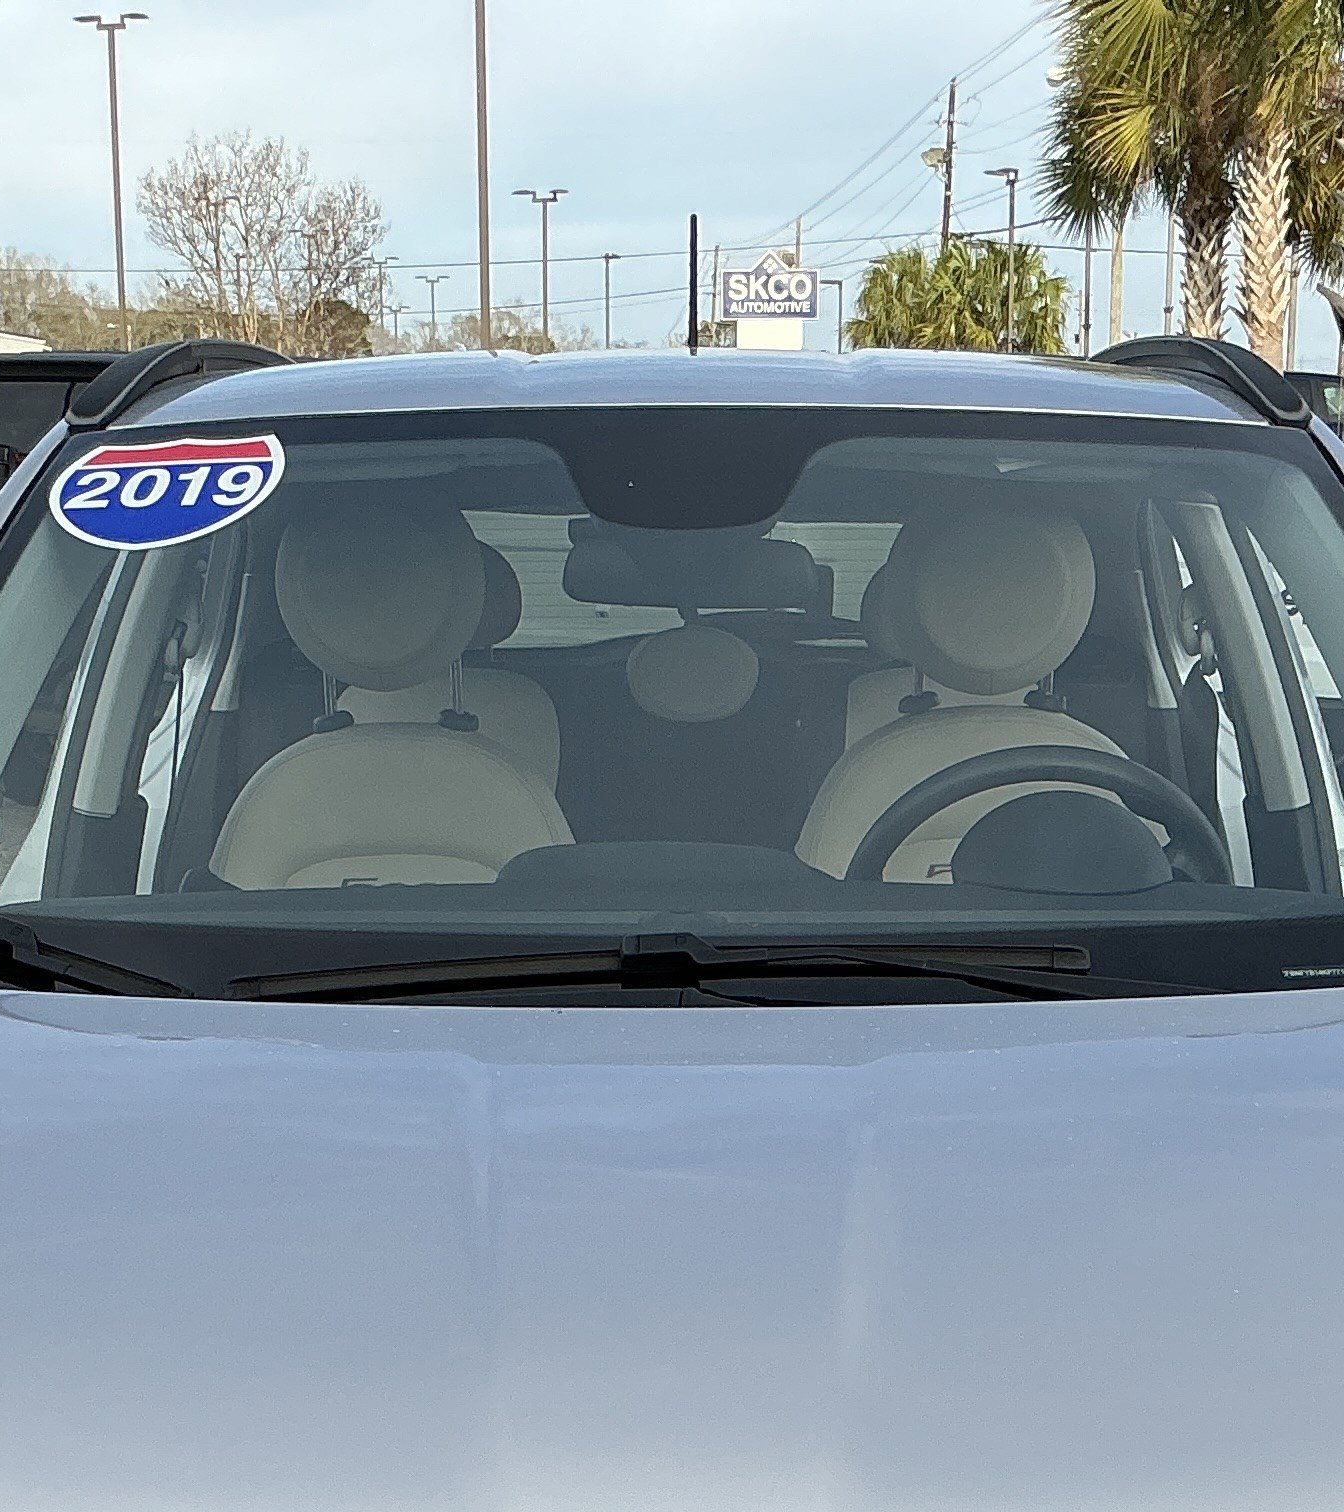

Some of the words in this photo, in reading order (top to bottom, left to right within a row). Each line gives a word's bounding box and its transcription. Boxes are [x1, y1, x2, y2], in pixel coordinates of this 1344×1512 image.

[727, 273, 813, 301] SKCO
[729, 301, 811, 314] AUTOMOTIVE
[62, 464, 265, 510] 2019
